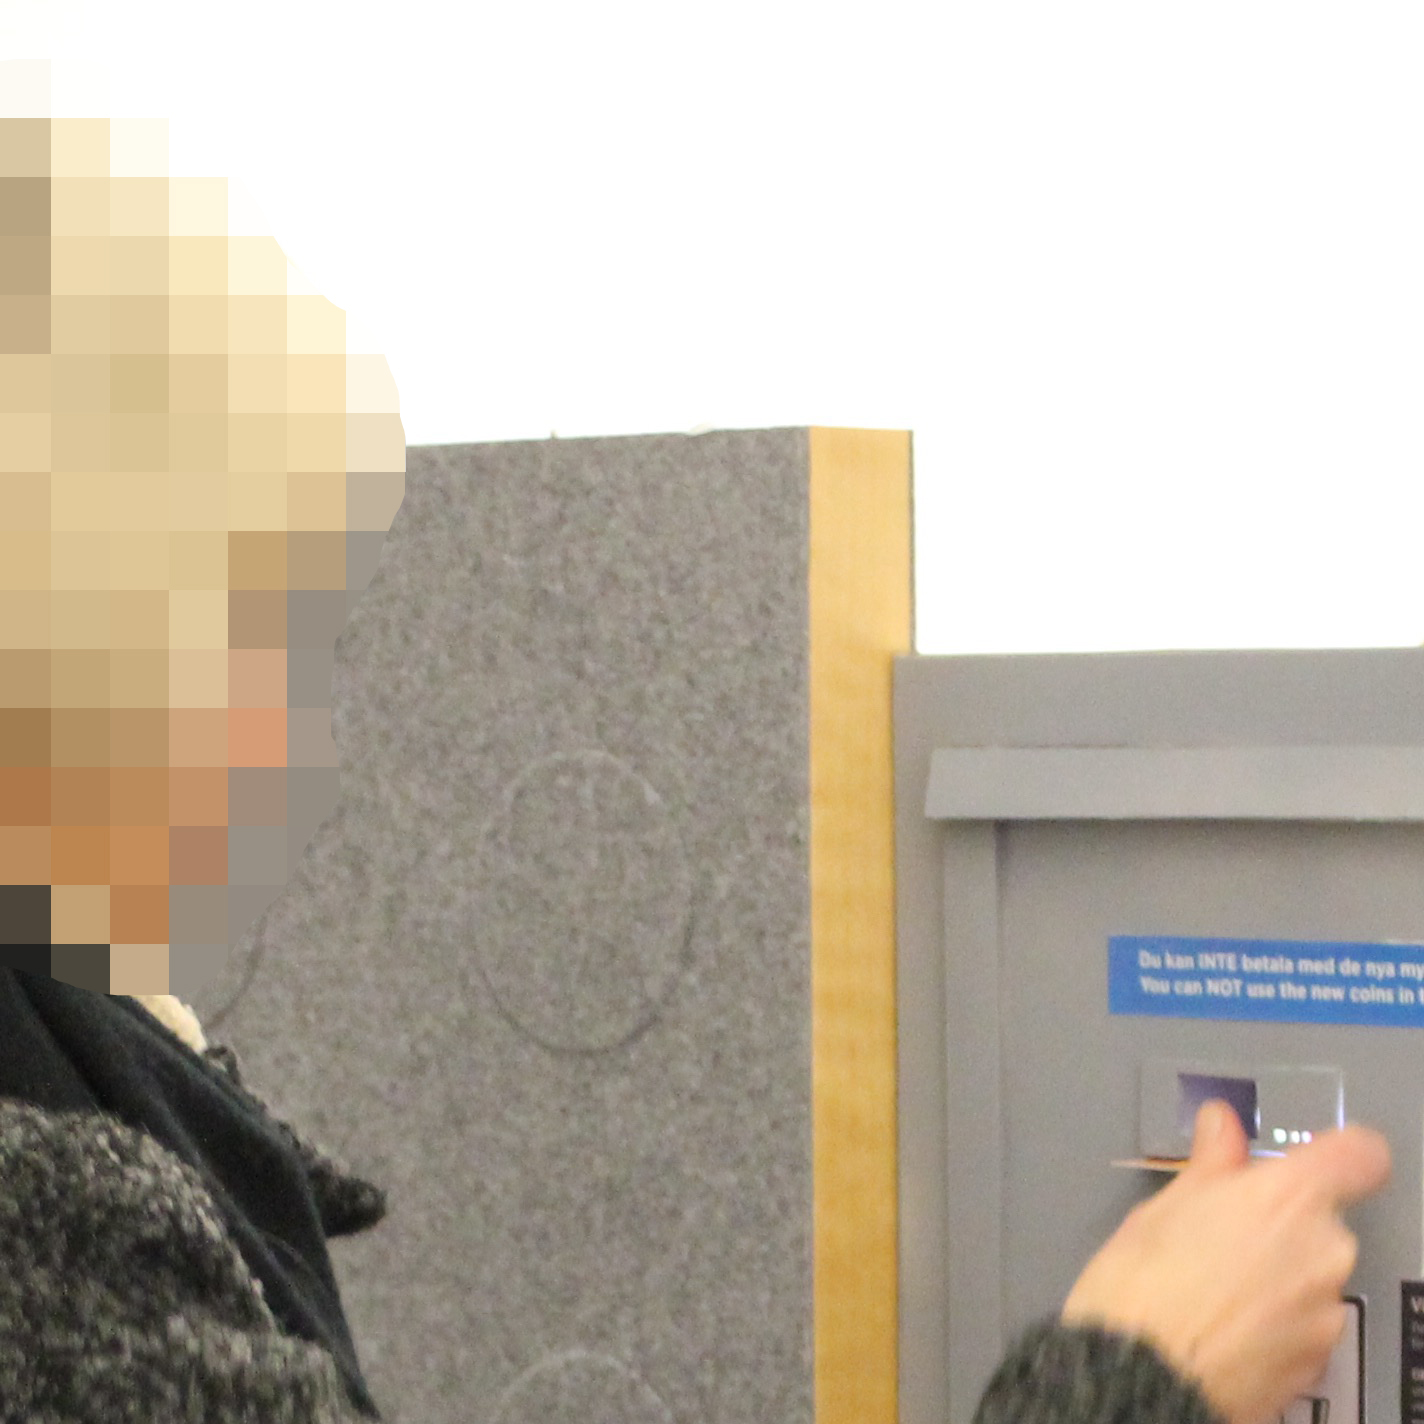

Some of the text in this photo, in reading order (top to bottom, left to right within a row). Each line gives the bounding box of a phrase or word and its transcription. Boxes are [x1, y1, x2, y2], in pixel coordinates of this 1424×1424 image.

[1139, 950, 1161, 969] Du
[1164, 951, 1194, 970] kan
[1198, 952, 1237, 971] INTE
[1242, 954, 1294, 974] betala
[1298, 957, 1335, 975] med
[1339, 957, 1361, 977] de
[1365, 961, 1395, 981] nya
[1140, 976, 1170, 994] You
[1174, 980, 1203, 996] can
[1206, 978, 1243, 997] NOT
[1247, 983, 1275, 998] use
[1279, 981, 1307, 999] the
[1311, 984, 1345, 1000] new
[1350, 985, 1394, 1004] coins
[1399, 985, 1414, 1004] in
